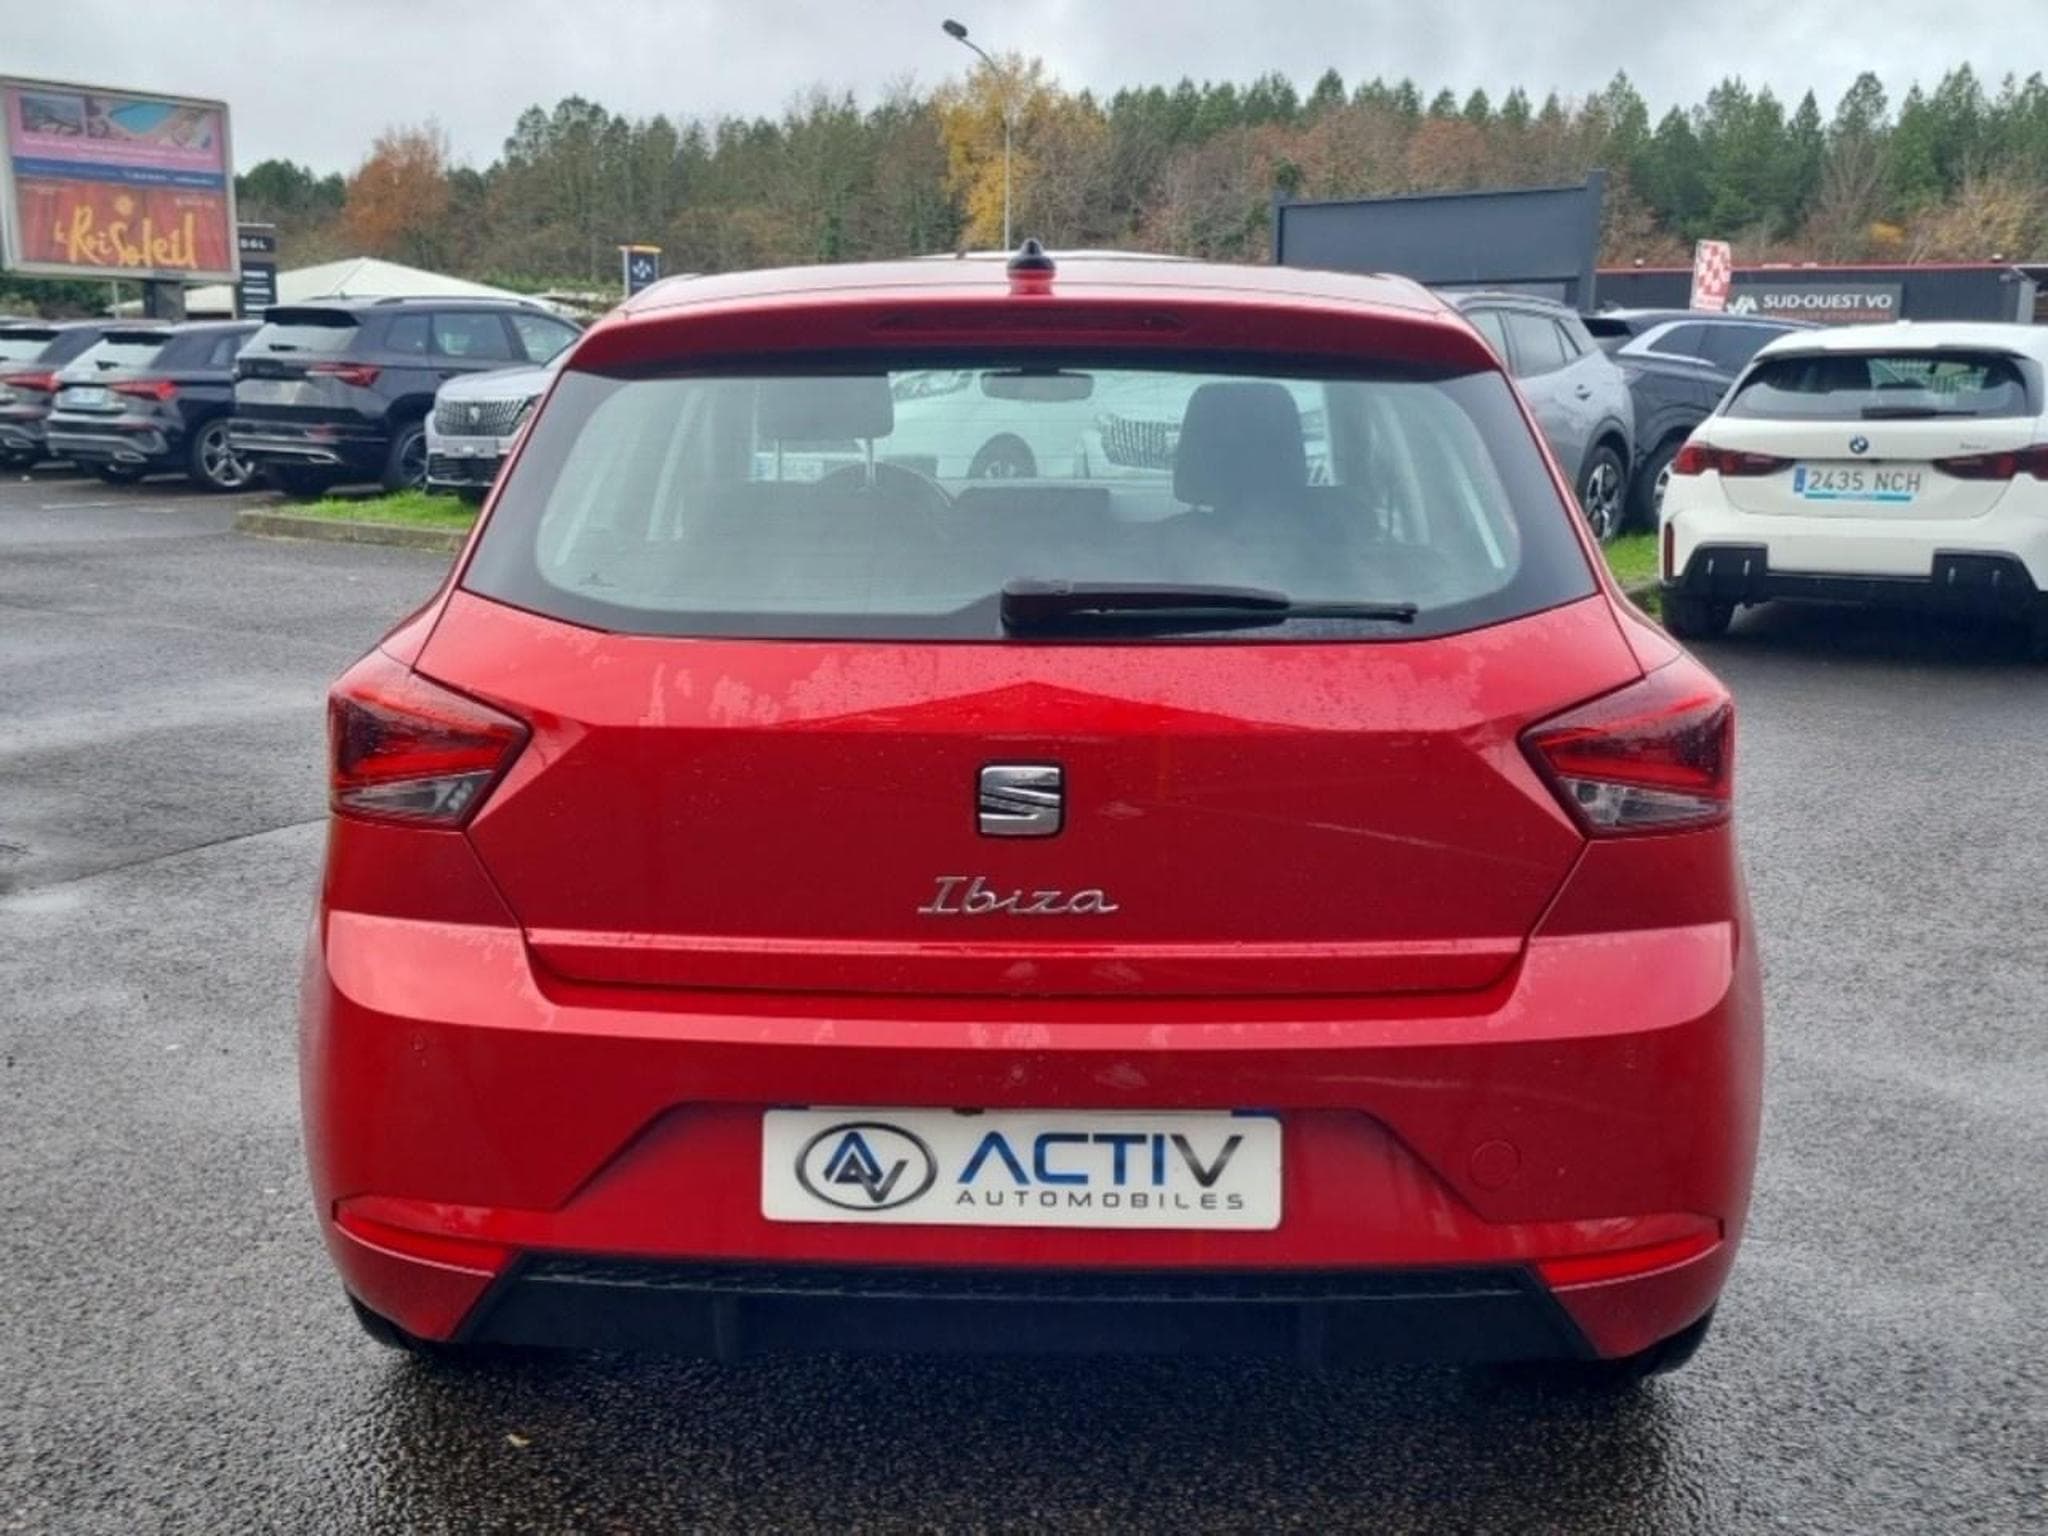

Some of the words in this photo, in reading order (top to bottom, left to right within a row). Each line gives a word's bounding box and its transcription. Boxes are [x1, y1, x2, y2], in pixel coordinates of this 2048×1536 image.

[109, 211, 198, 269] Soleil
[1763, 293, 1861, 309] SUD-OUEST
[1865, 294, 1893, 309] VO
[1809, 470, 1864, 491] 2435
[1874, 472, 1921, 492] NCH
[917, 875, 1119, 915] Ibiza
[957, 1131, 1244, 1188] ACTIV
[956, 1189, 1244, 1210] AUTOMOBILES
